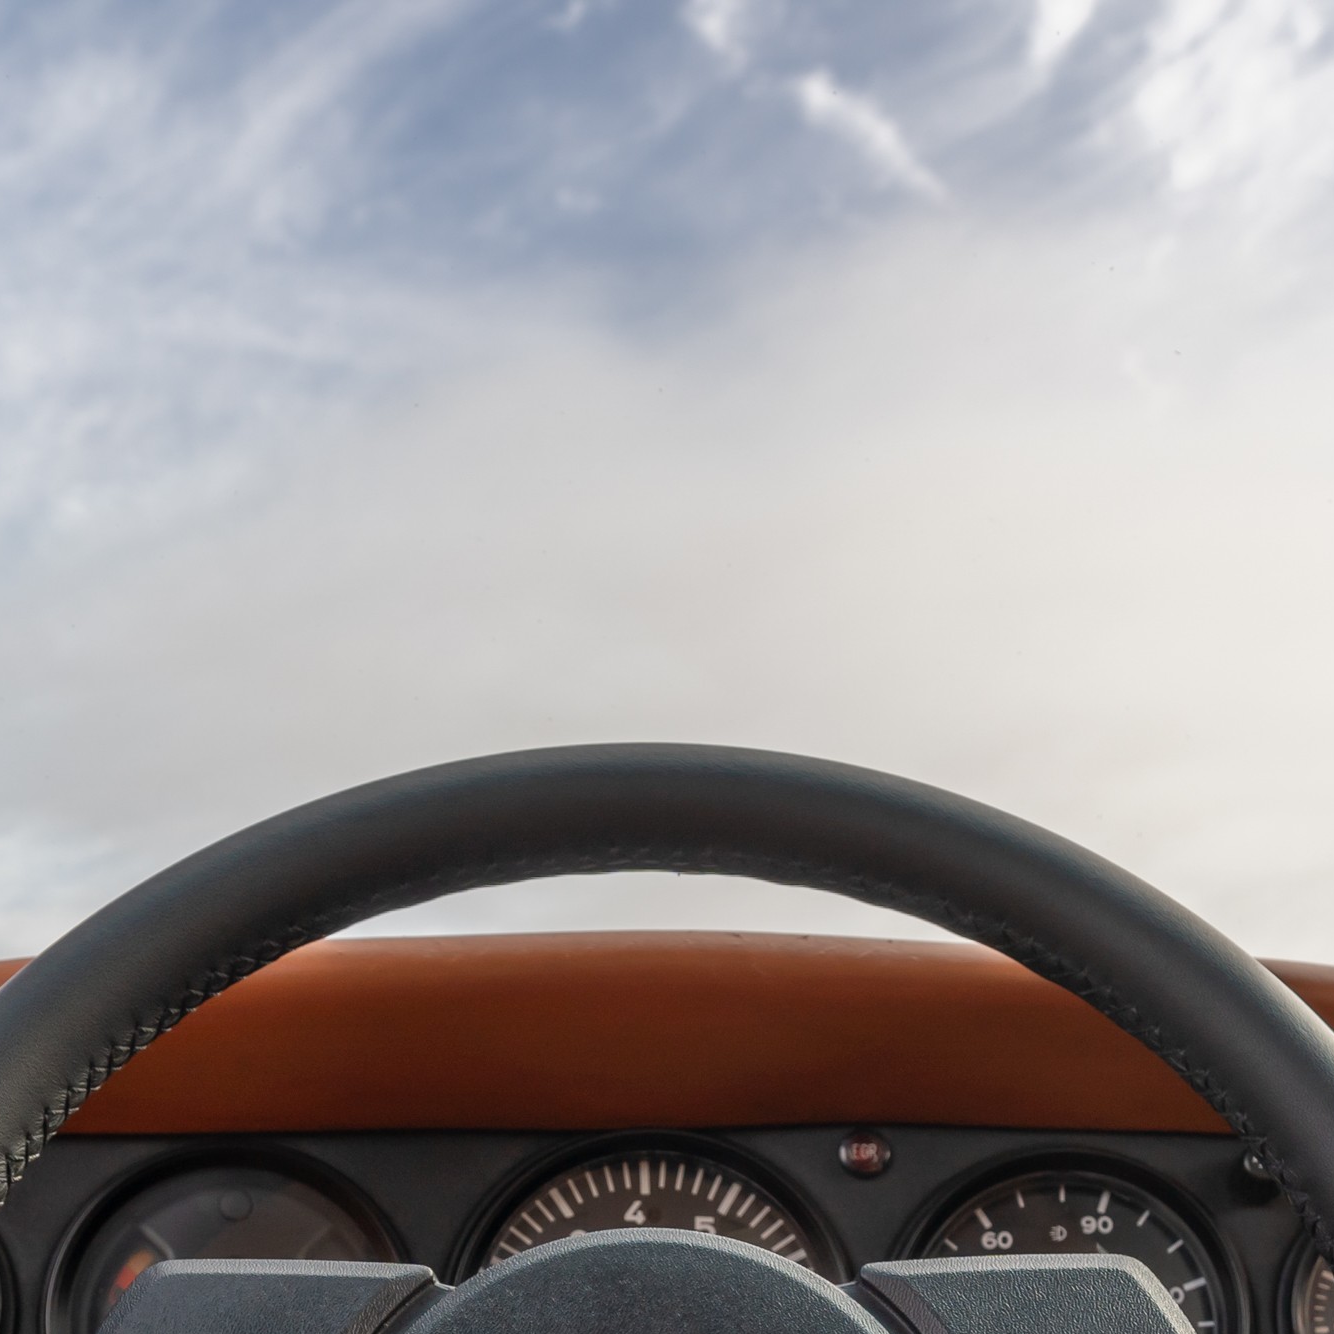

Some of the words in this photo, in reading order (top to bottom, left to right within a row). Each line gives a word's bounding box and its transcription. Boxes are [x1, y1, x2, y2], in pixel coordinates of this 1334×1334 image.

[623, 1199, 647, 1226] 4
[1080, 1215, 1114, 1236] 90
[981, 1230, 1013, 1251] 60
